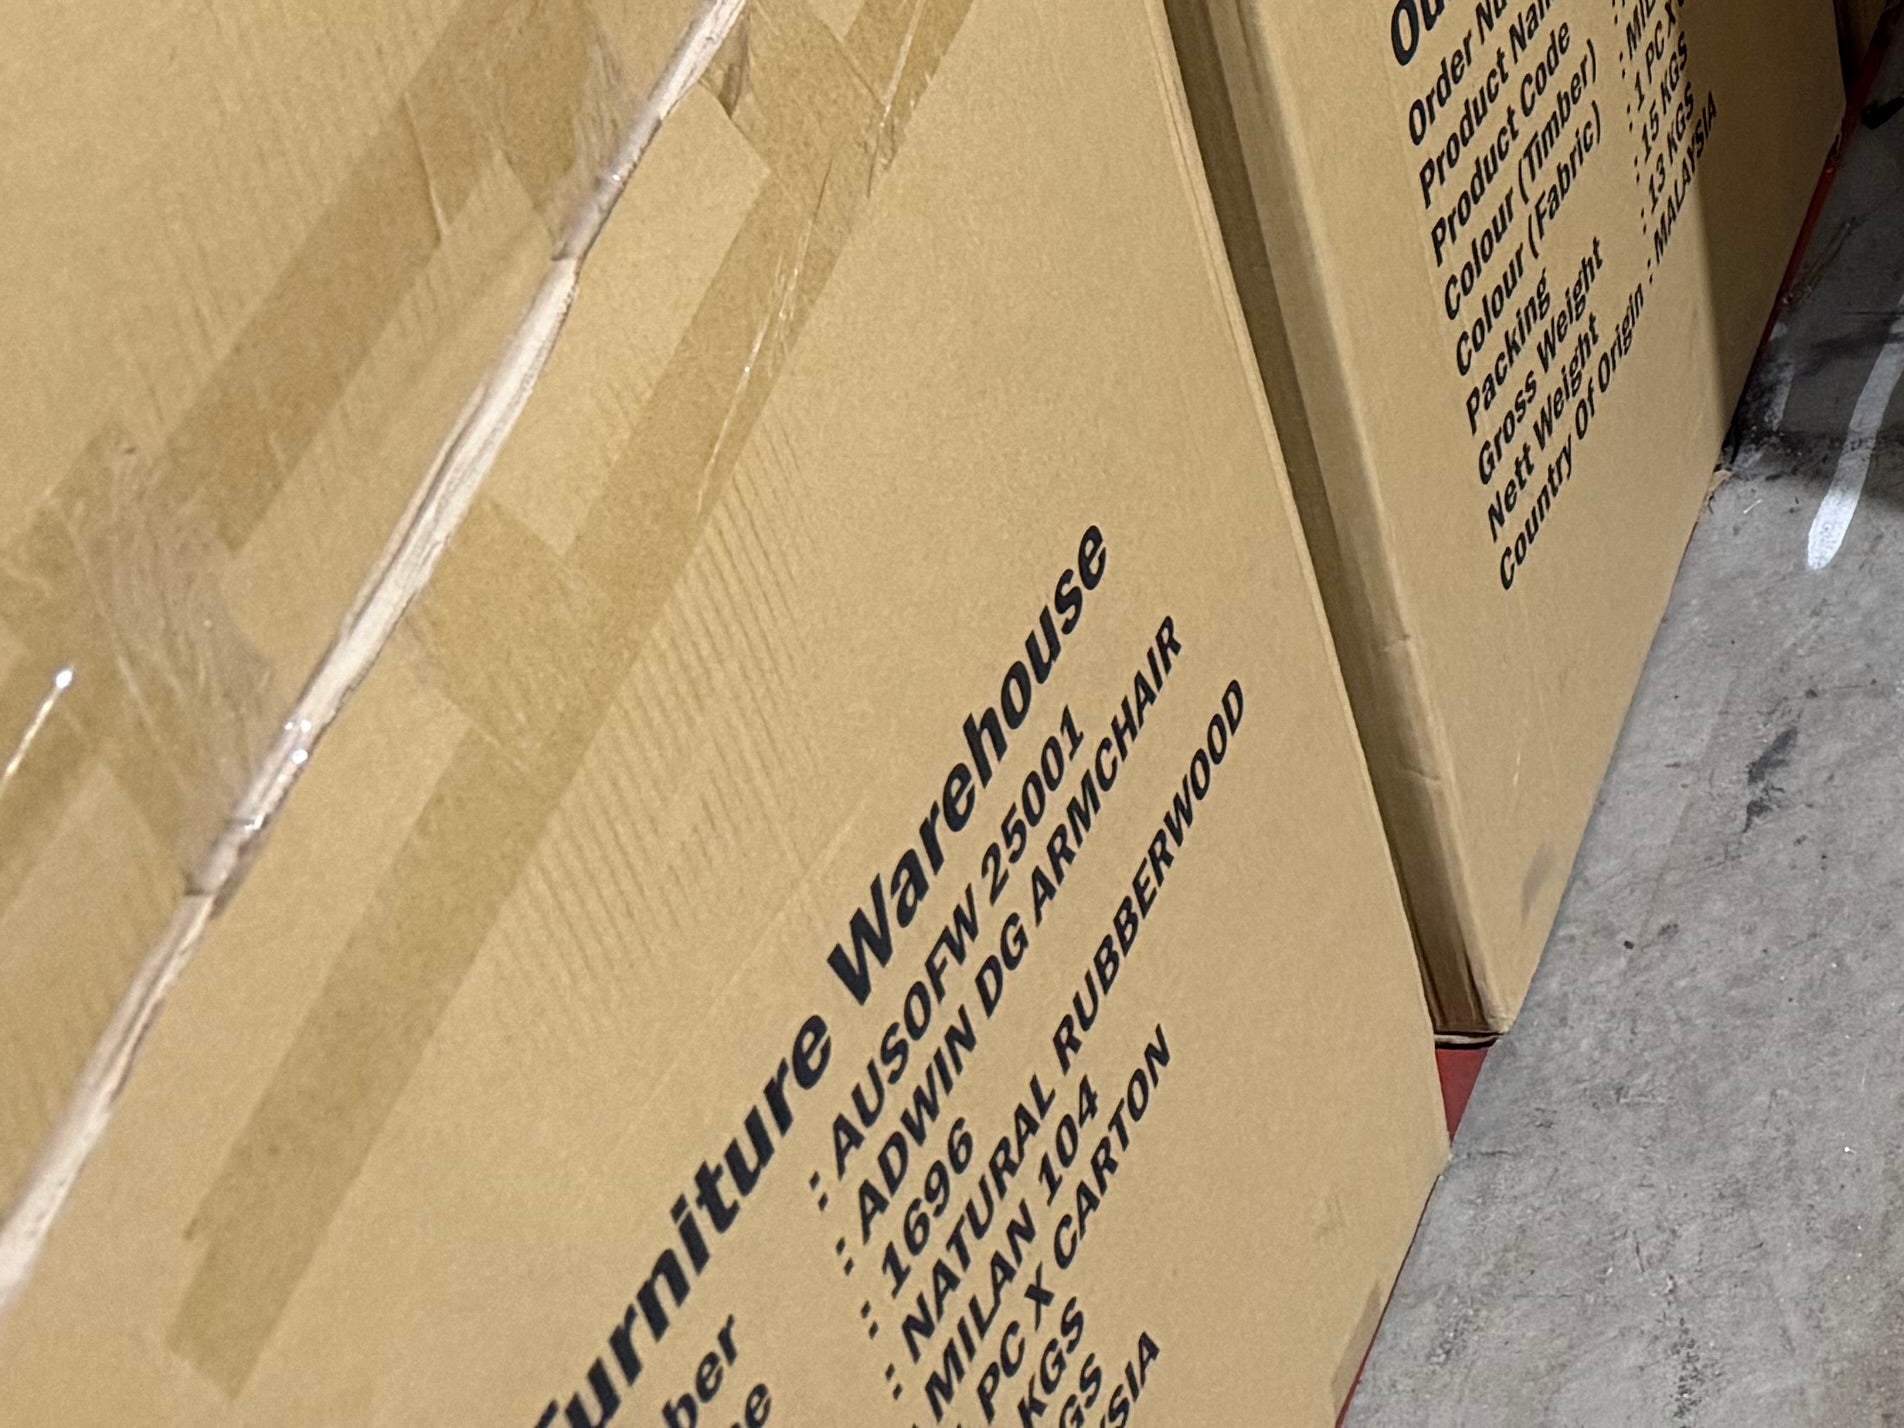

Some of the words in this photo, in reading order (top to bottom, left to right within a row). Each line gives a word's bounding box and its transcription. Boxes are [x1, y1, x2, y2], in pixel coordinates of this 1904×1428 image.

[1409, 29, 1472, 146] Order
[1419, 47, 1508, 209] Product
[1431, 105, 1519, 267] Product
[1520, 22, 1570, 117] Code
[1445, 187, 1513, 320] Colour
[1518, 39, 1596, 205] (Timber)
[1500, 434, 1571, 590] Country
[1575, 377, 1594, 440] Of
[1598, 283, 1643, 393] Origin
[1654, 91, 1716, 264] MALAYSIA
[534, 1015, 831, 1428] urniture
[827, 525, 1106, 1006] Warehouse
[833, 883, 978, 1180] AUSOFW
[982, 705, 1084, 906] 25001
[858, 1004, 976, 1245] ADWIN
[975, 913, 1028, 1018] DG
[1032, 616, 1181, 927] ARMCHAIR
[902, 1074, 1055, 1364] NATURAL
[1053, 680, 1243, 1076] RUBBERWOOD
[882, 1117, 973, 1299] 1696
[925, 1198, 1035, 1424] MILAN
[1039, 1075, 1097, 1206] 104
[977, 1321, 1025, 1425] PC
[1024, 1262, 1054, 1331] X
[1054, 1024, 1170, 1269] CARTON
[1017, 1297, 1083, 1428] KGS
